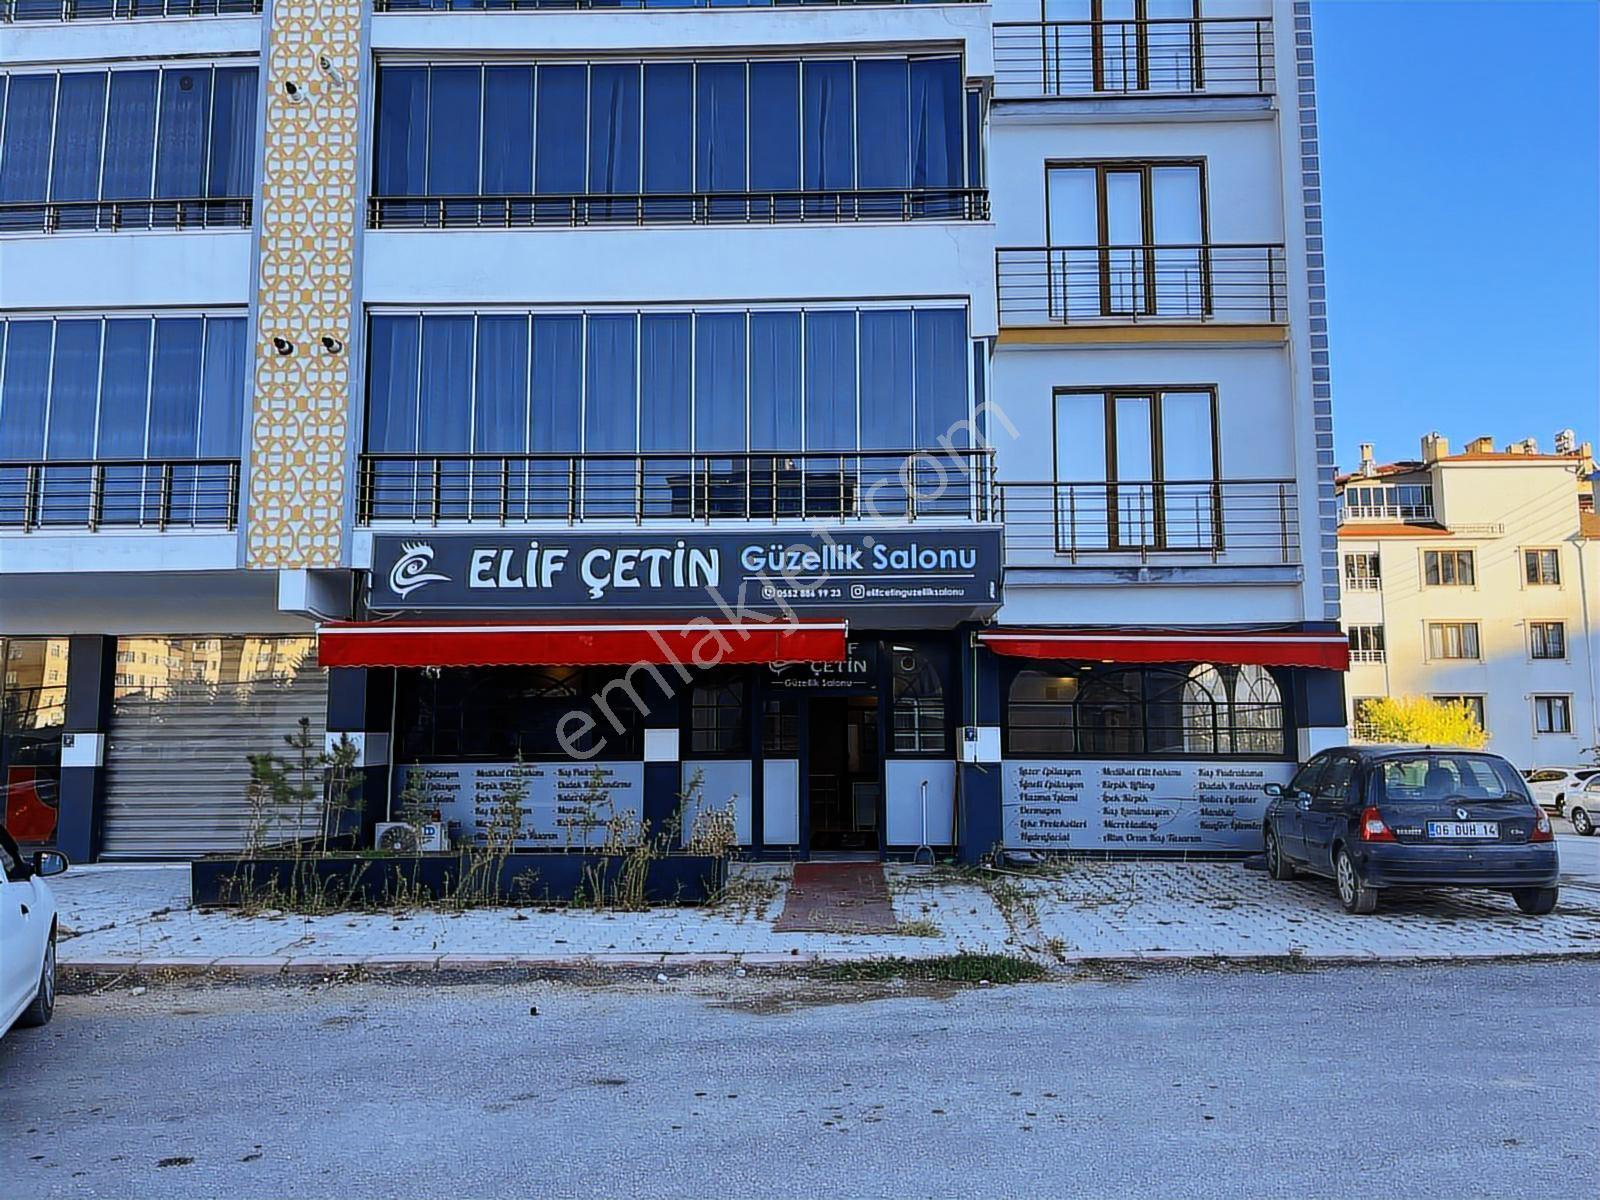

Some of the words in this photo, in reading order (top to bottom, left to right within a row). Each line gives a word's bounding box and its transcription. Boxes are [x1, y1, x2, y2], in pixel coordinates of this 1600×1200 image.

[470, 541, 569, 588] ELİF
[581, 540, 719, 599] ÇETİN
[741, 544, 864, 571] Güzellik
[872, 543, 976, 570] Salonu
[1436, 824, 1449, 835] 06
[1483, 824, 1496, 835] 14
